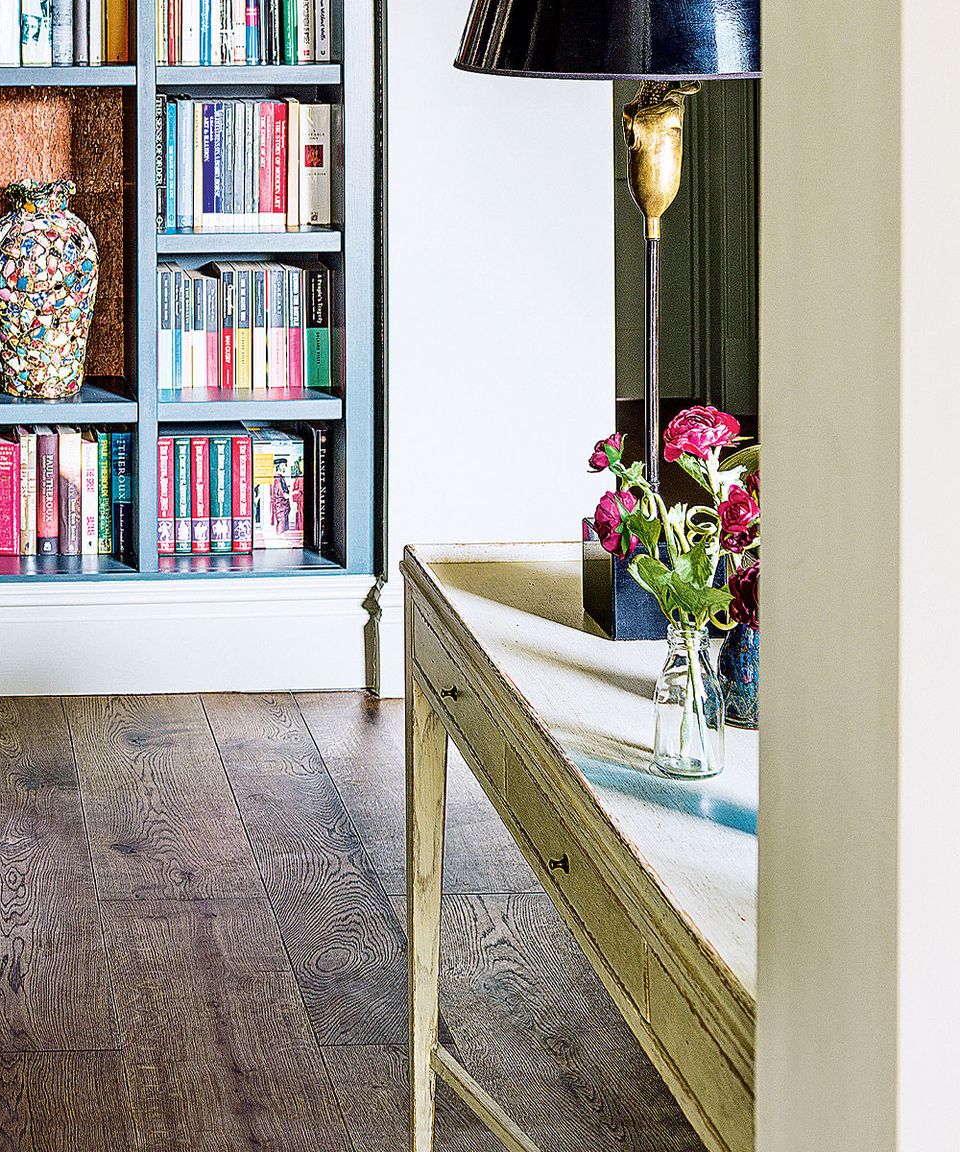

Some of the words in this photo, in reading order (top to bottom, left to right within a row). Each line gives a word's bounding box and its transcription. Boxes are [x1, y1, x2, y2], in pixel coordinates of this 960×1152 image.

[155, 98, 163, 117] THE
[155, 118, 163, 143] SENSE
[155, 143, 163, 155] OF
[155, 156, 163, 186] ORDER
[46, 454, 54, 478] PAUL
[118, 444, 126, 500] THEROUX
[46, 479, 54, 522] THEROUX
